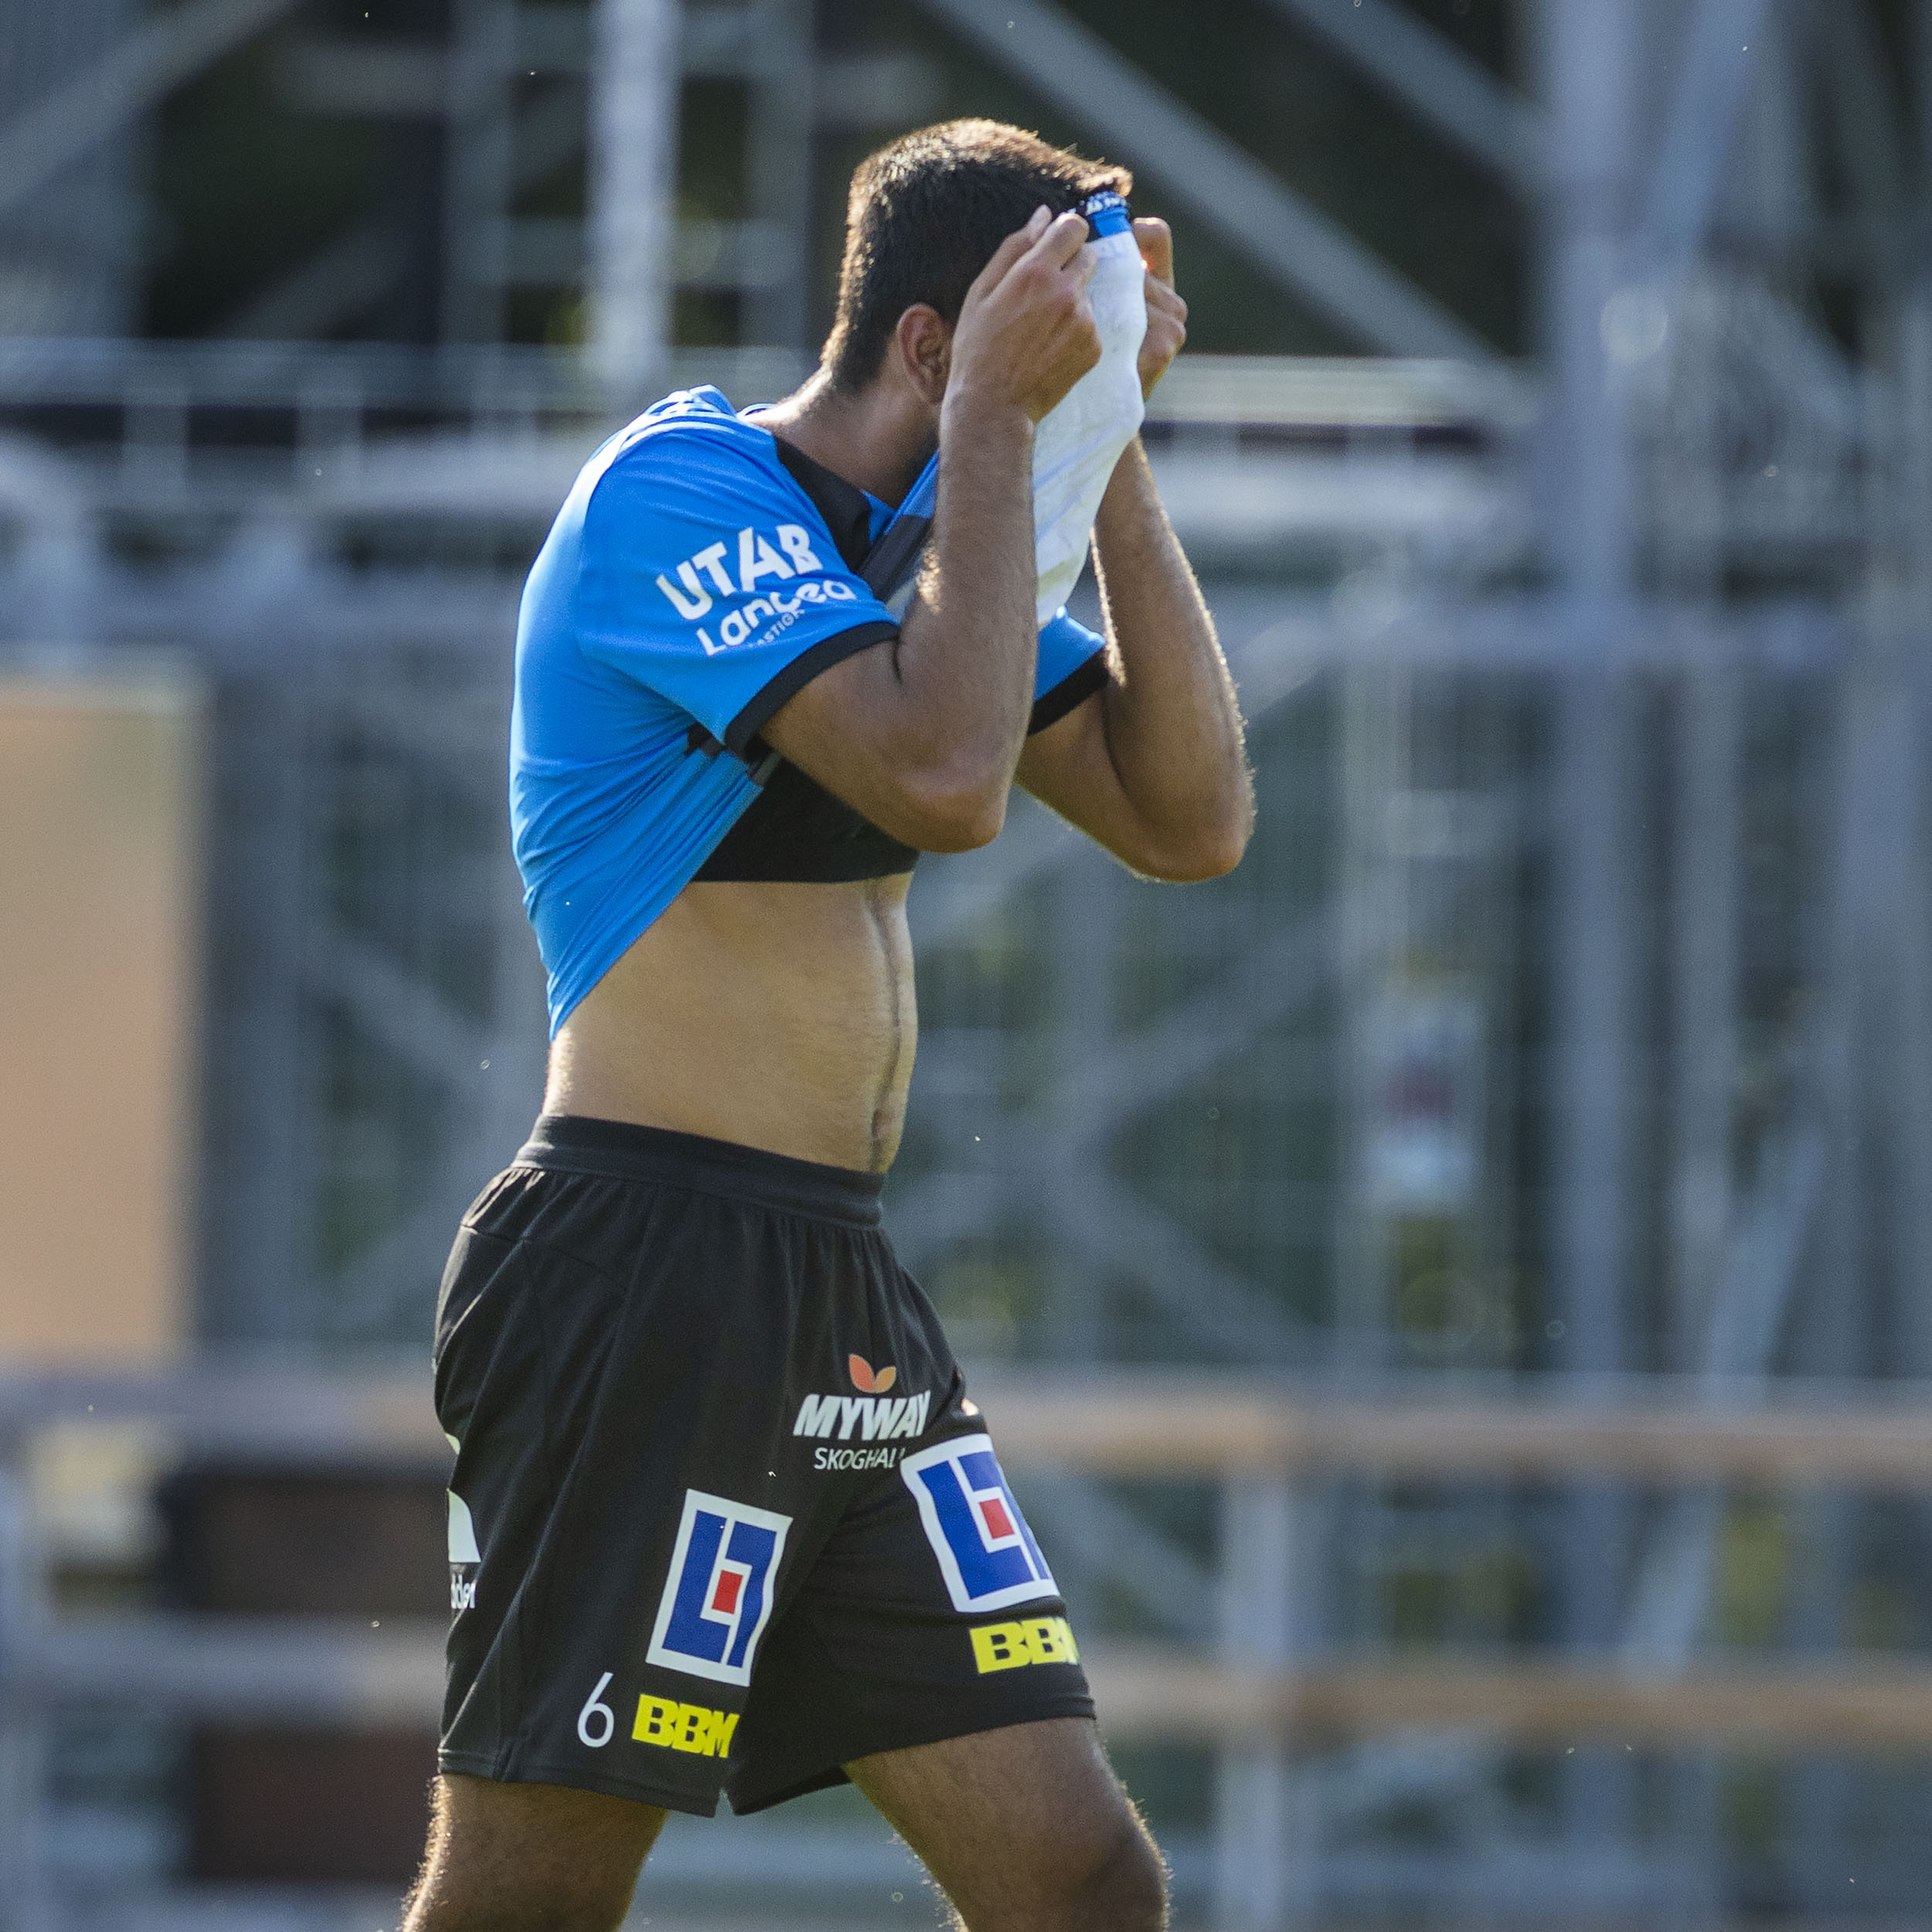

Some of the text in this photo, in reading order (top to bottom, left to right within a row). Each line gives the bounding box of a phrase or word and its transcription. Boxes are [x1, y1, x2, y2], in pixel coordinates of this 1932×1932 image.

[656, 524, 822, 620] UTAB
[793, 1390, 930, 1441] MYWAY
[577, 1672, 614, 1747] 6
[631, 1693, 740, 1758] BBM
